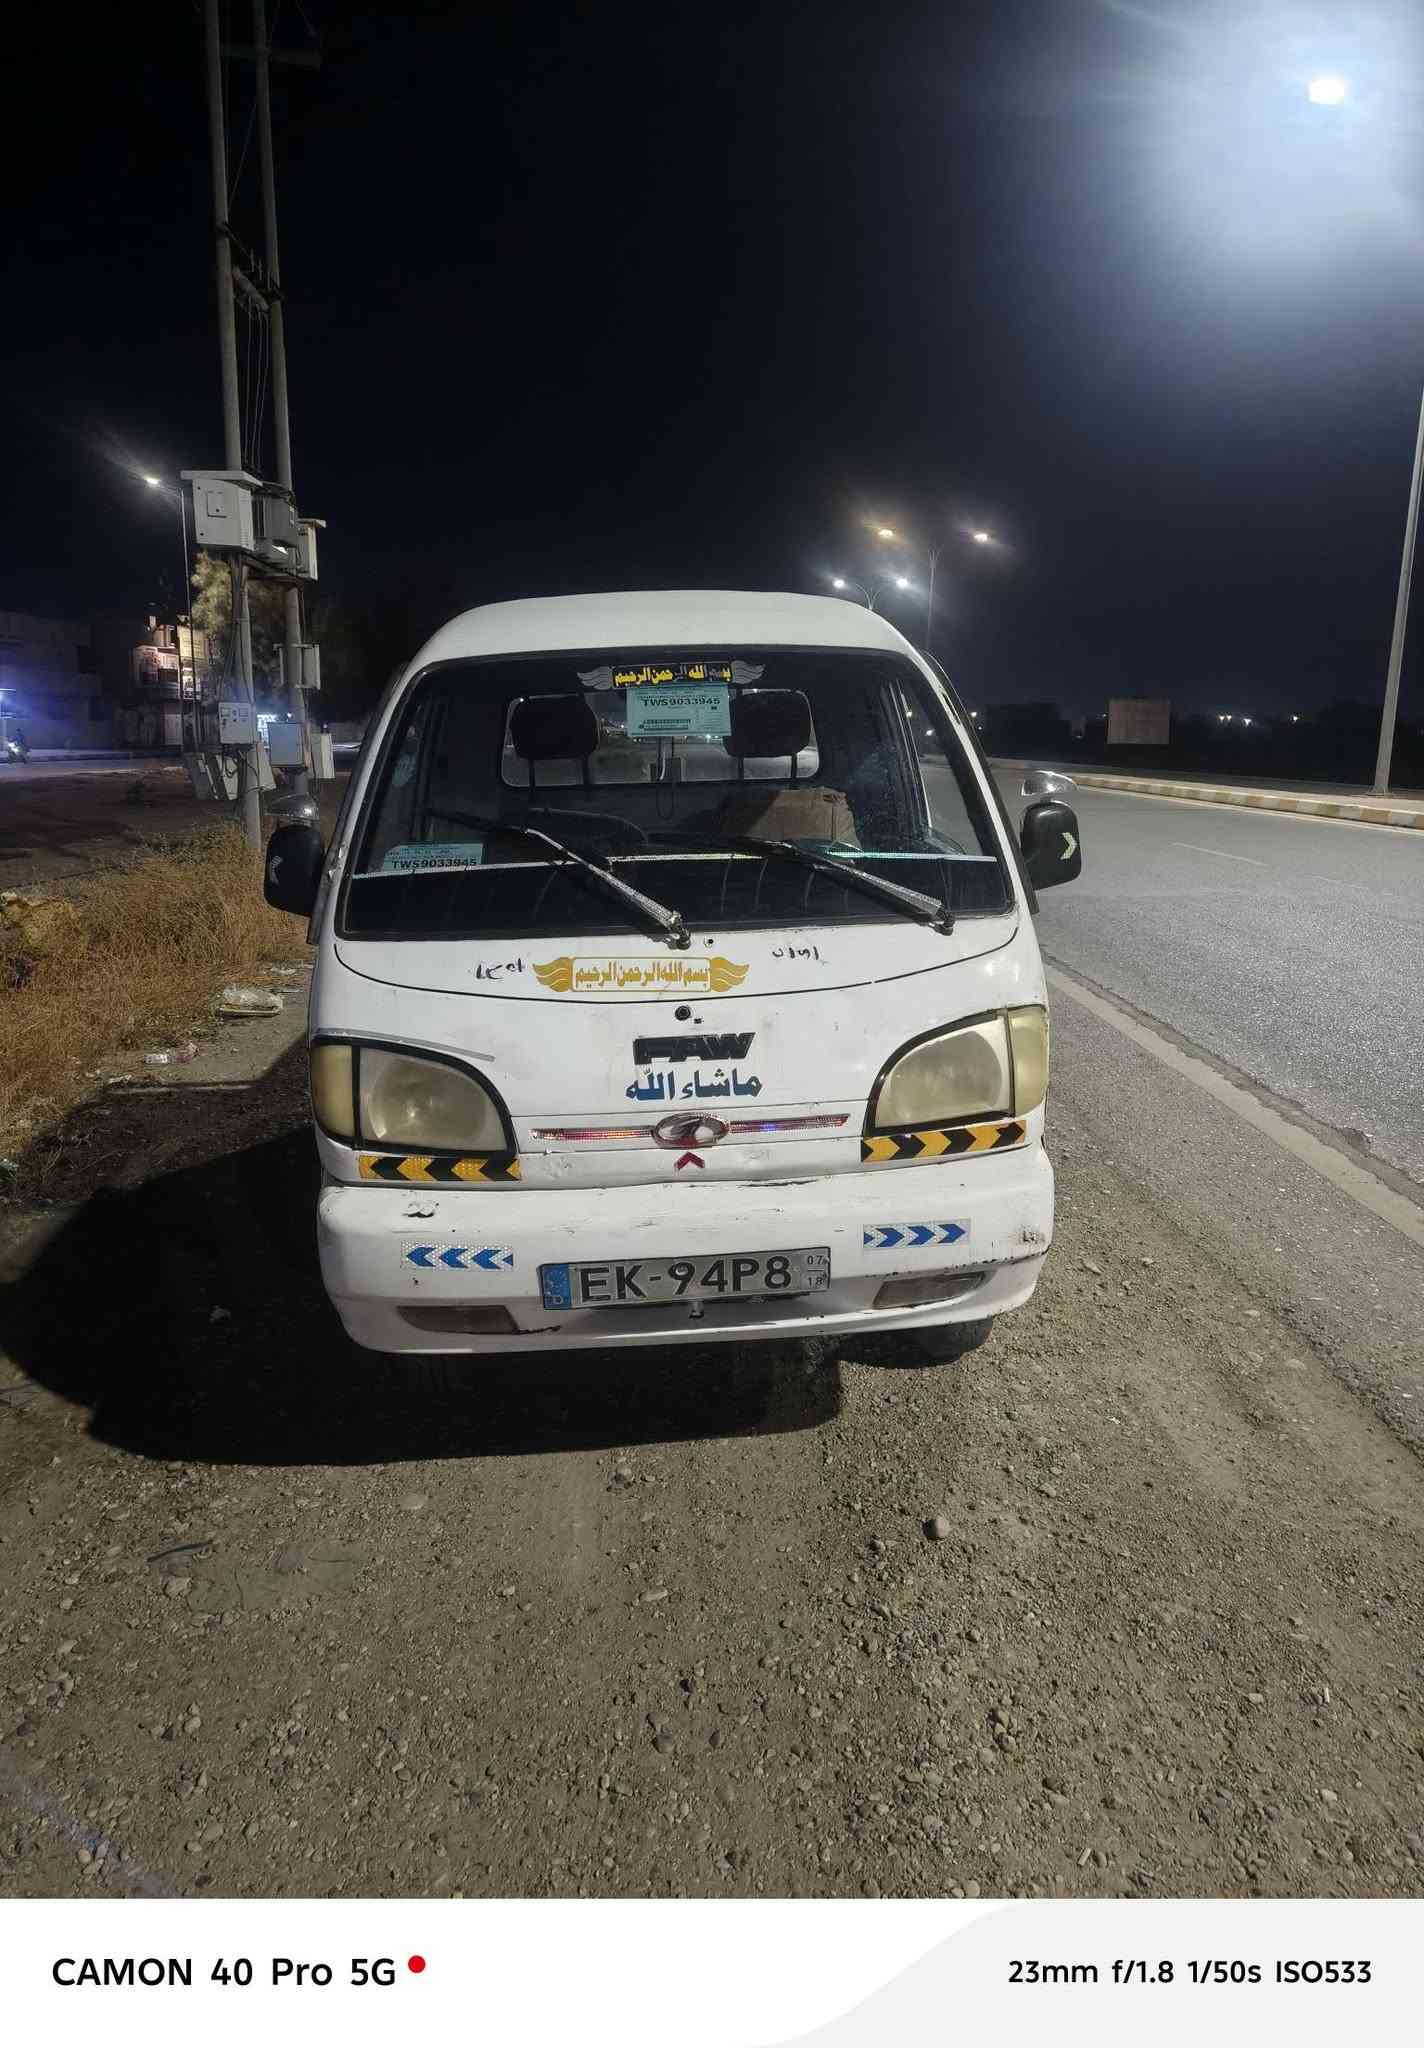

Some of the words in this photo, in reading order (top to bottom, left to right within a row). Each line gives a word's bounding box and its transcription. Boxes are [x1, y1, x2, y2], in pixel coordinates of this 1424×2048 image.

[615, 666, 651, 687] الرحيم
[642, 696, 721, 707] TWS9033945
[391, 858, 477, 870] TWS9033945
[575, 961, 618, 989] الرحيم
[617, 961, 660, 987] الرحمن
[661, 961, 683, 982] الله
[683, 967, 710, 988] بسم
[625, 1067, 676, 1101] الله
[680, 1068, 762, 1099] ماشاء
[808, 1255, 824, 1265] 07
[580, 1255, 792, 1303] EK-94P8
